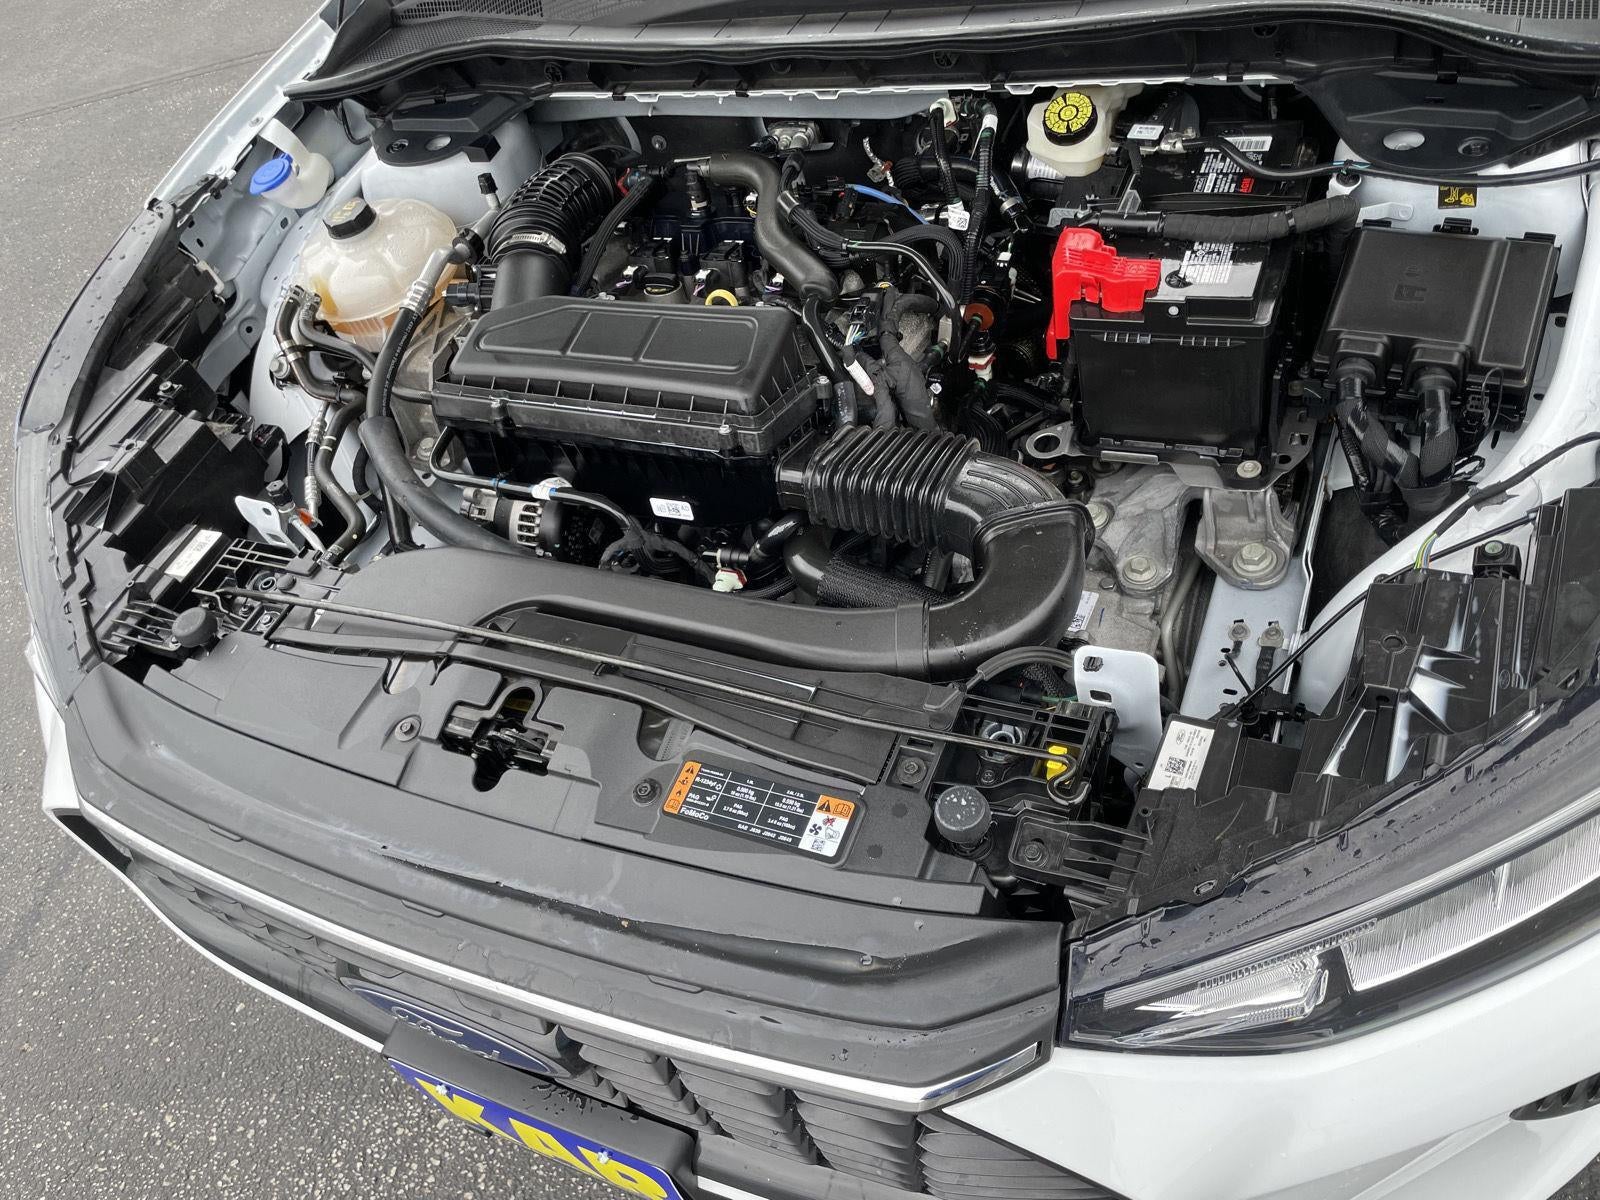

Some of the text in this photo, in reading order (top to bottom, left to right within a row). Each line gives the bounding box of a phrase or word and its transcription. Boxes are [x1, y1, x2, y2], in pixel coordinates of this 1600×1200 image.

[695, 776, 717, 787] R-1234yf
[687, 792, 700, 800] PAG
[748, 788, 755, 796] kg
[794, 800, 801, 808] kg
[680, 807, 709, 821] FoMoCo
[737, 823, 748, 831] SAE
